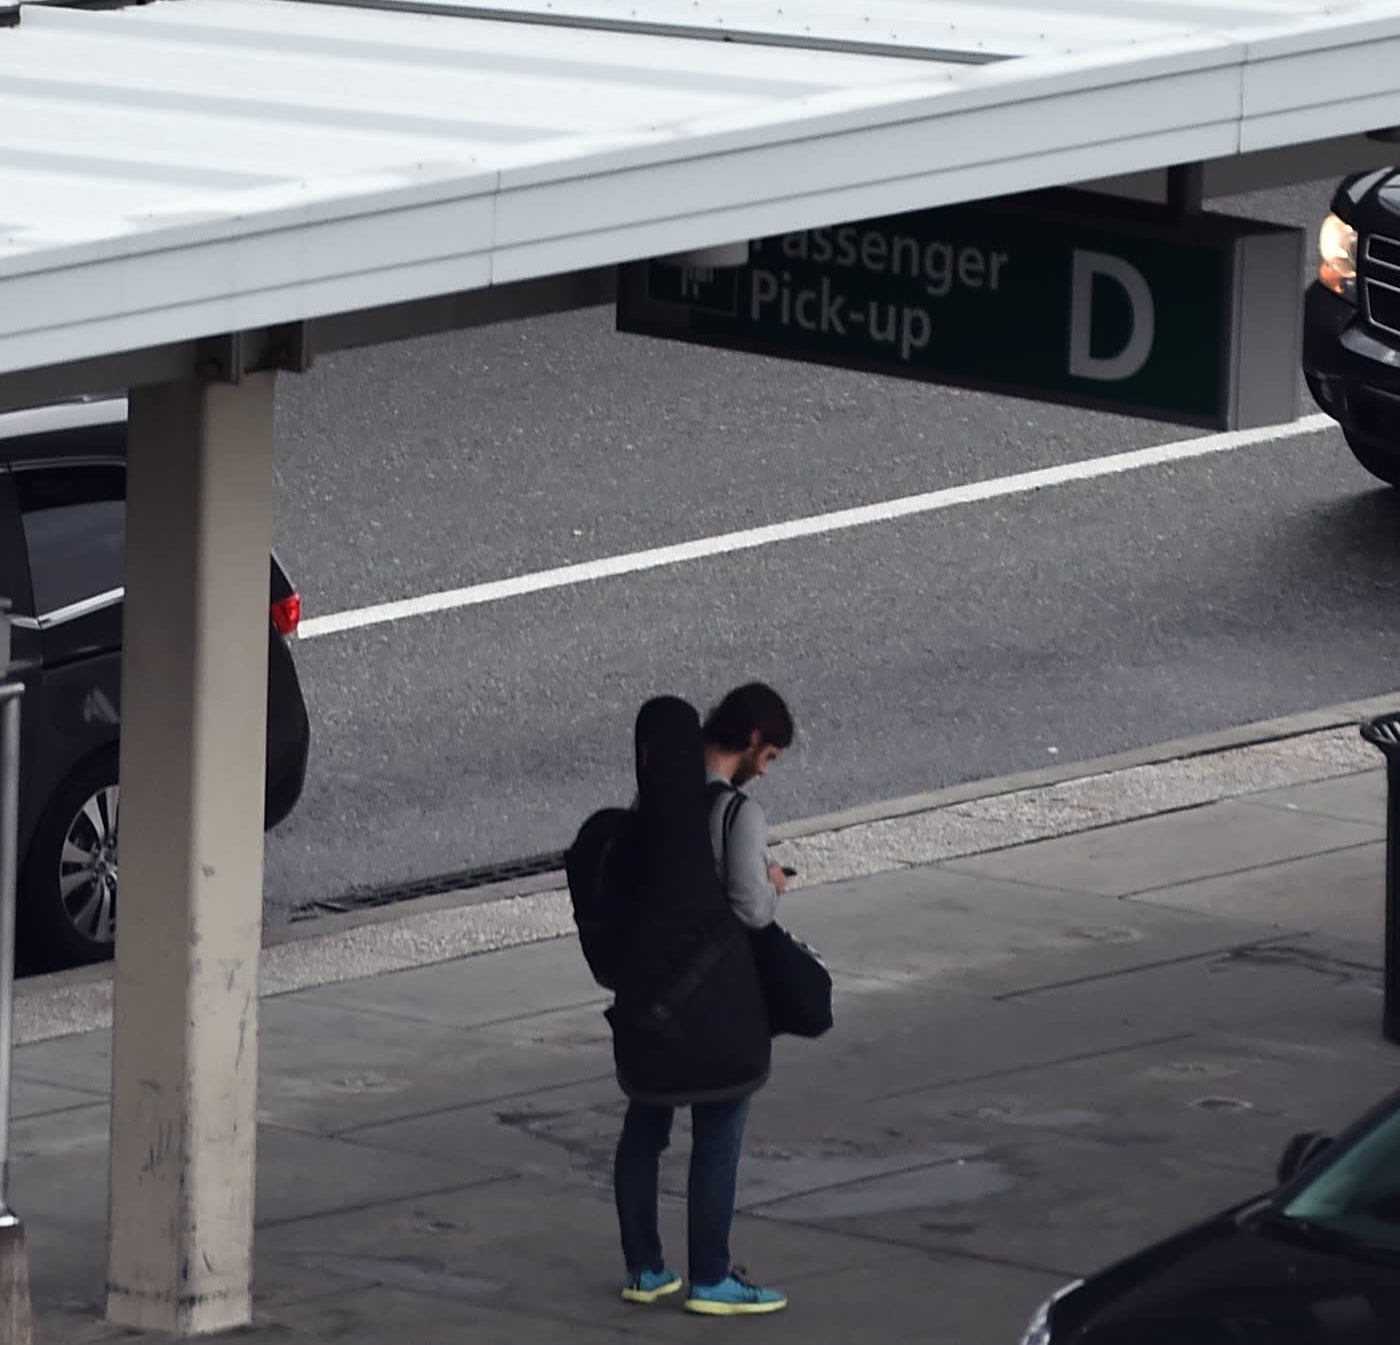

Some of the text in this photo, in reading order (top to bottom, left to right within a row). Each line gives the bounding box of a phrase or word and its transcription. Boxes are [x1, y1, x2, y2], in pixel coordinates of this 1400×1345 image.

[754, 222, 1010, 295] assenger
[750, 268, 934, 361] Pick-up
[1068, 248, 1157, 382] D
